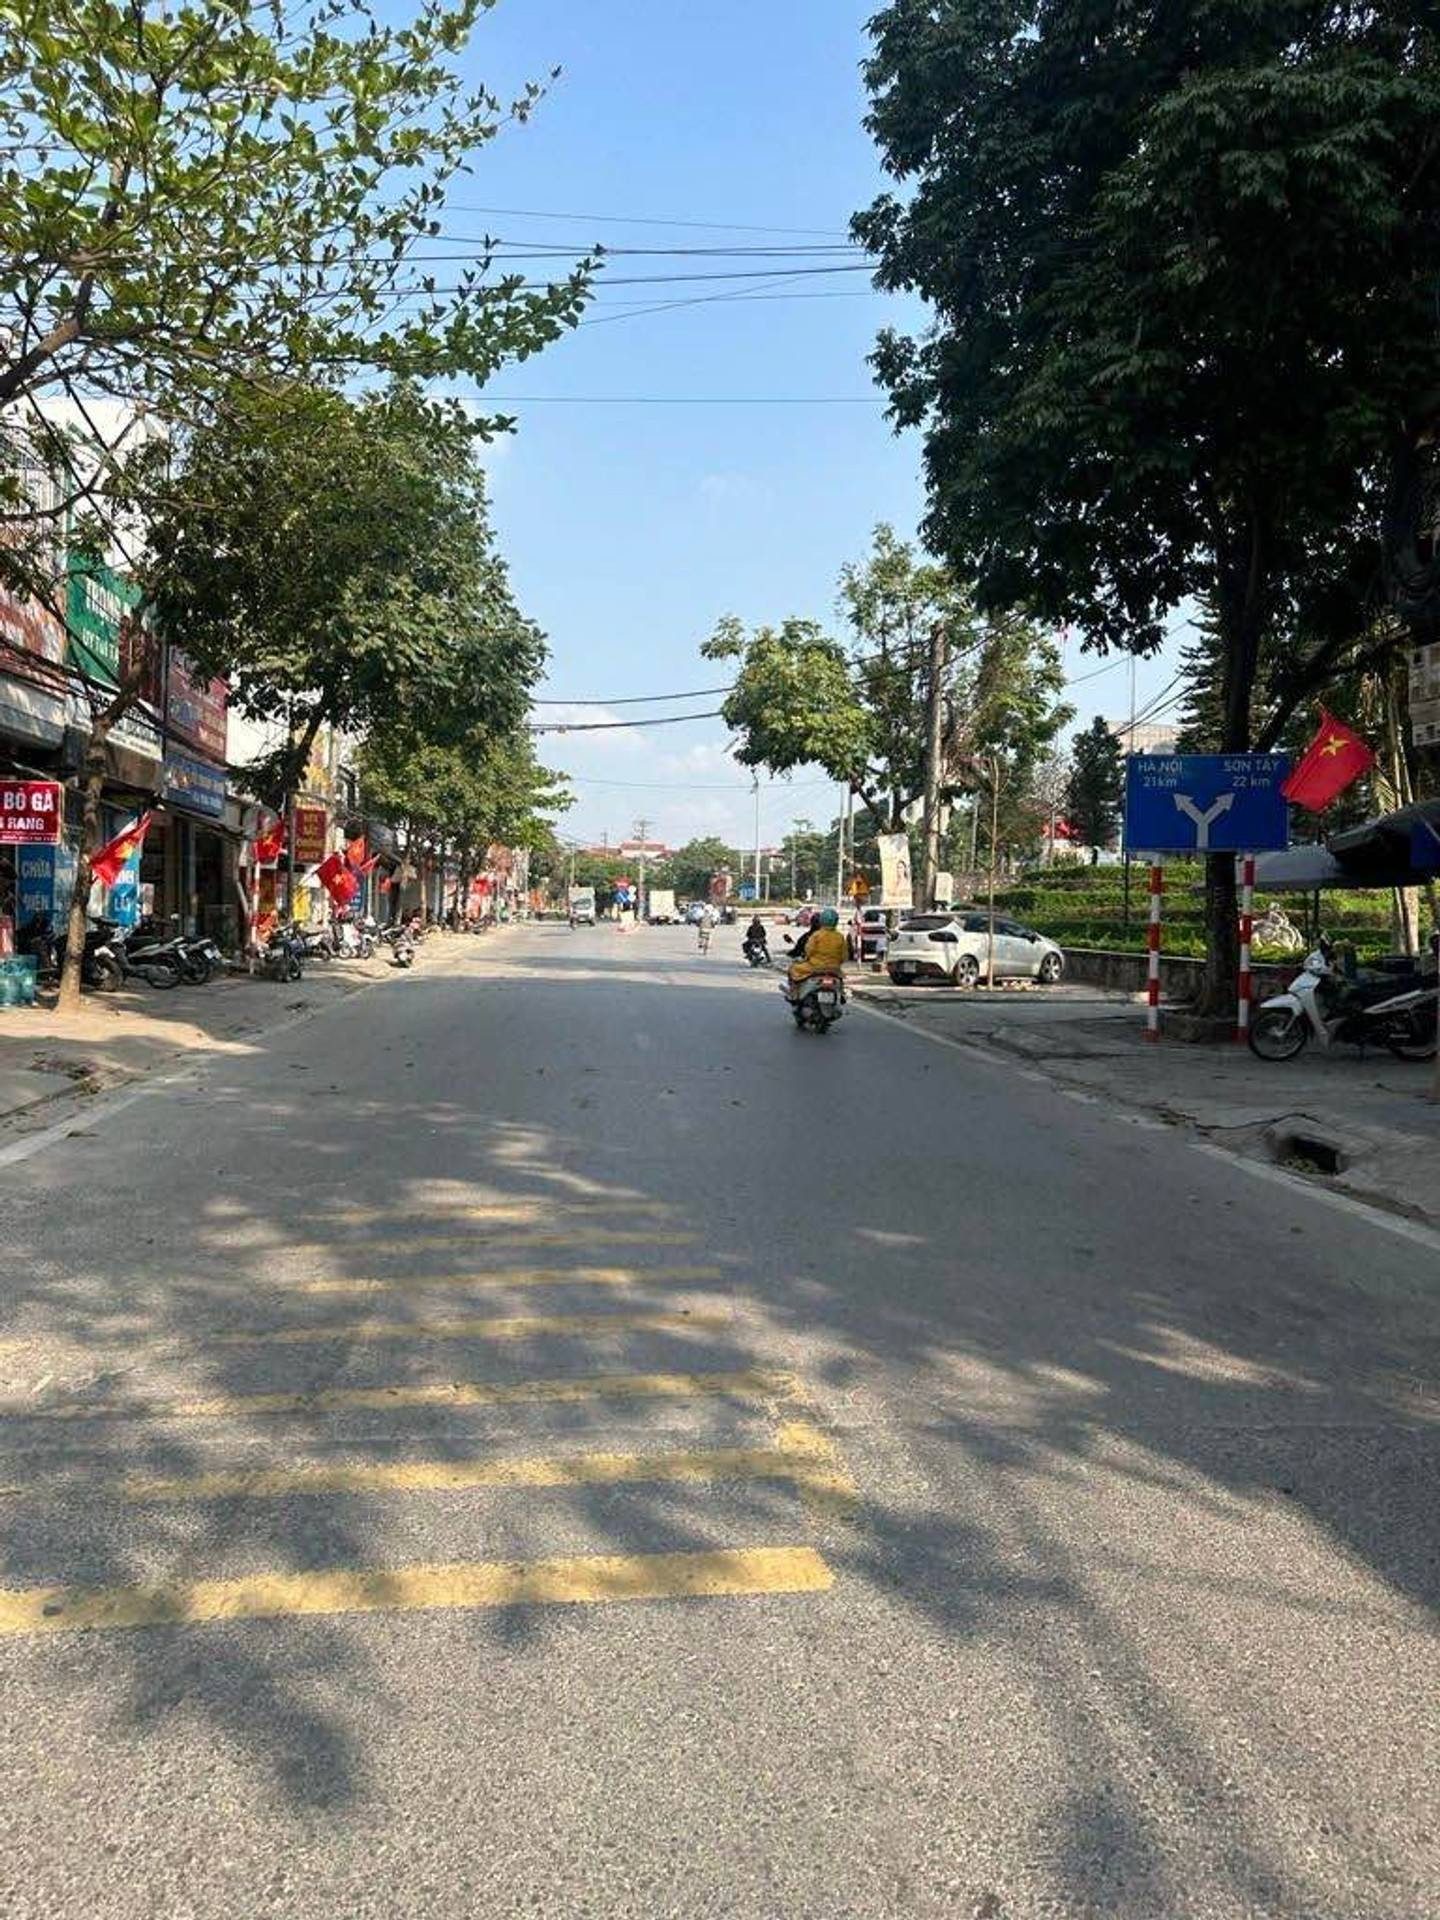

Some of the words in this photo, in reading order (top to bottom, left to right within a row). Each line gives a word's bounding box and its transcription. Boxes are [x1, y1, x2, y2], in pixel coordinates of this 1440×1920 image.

[1160, 757, 1183, 775] NỘI
[1223, 759, 1250, 773] SƠN
[1255, 757, 1279, 772] TÂY
[1232, 775, 1246, 787] 22
[1250, 775, 1271, 787] km
[31, 789, 54, 812] GÀ
[7, 817, 45, 830] RANG
